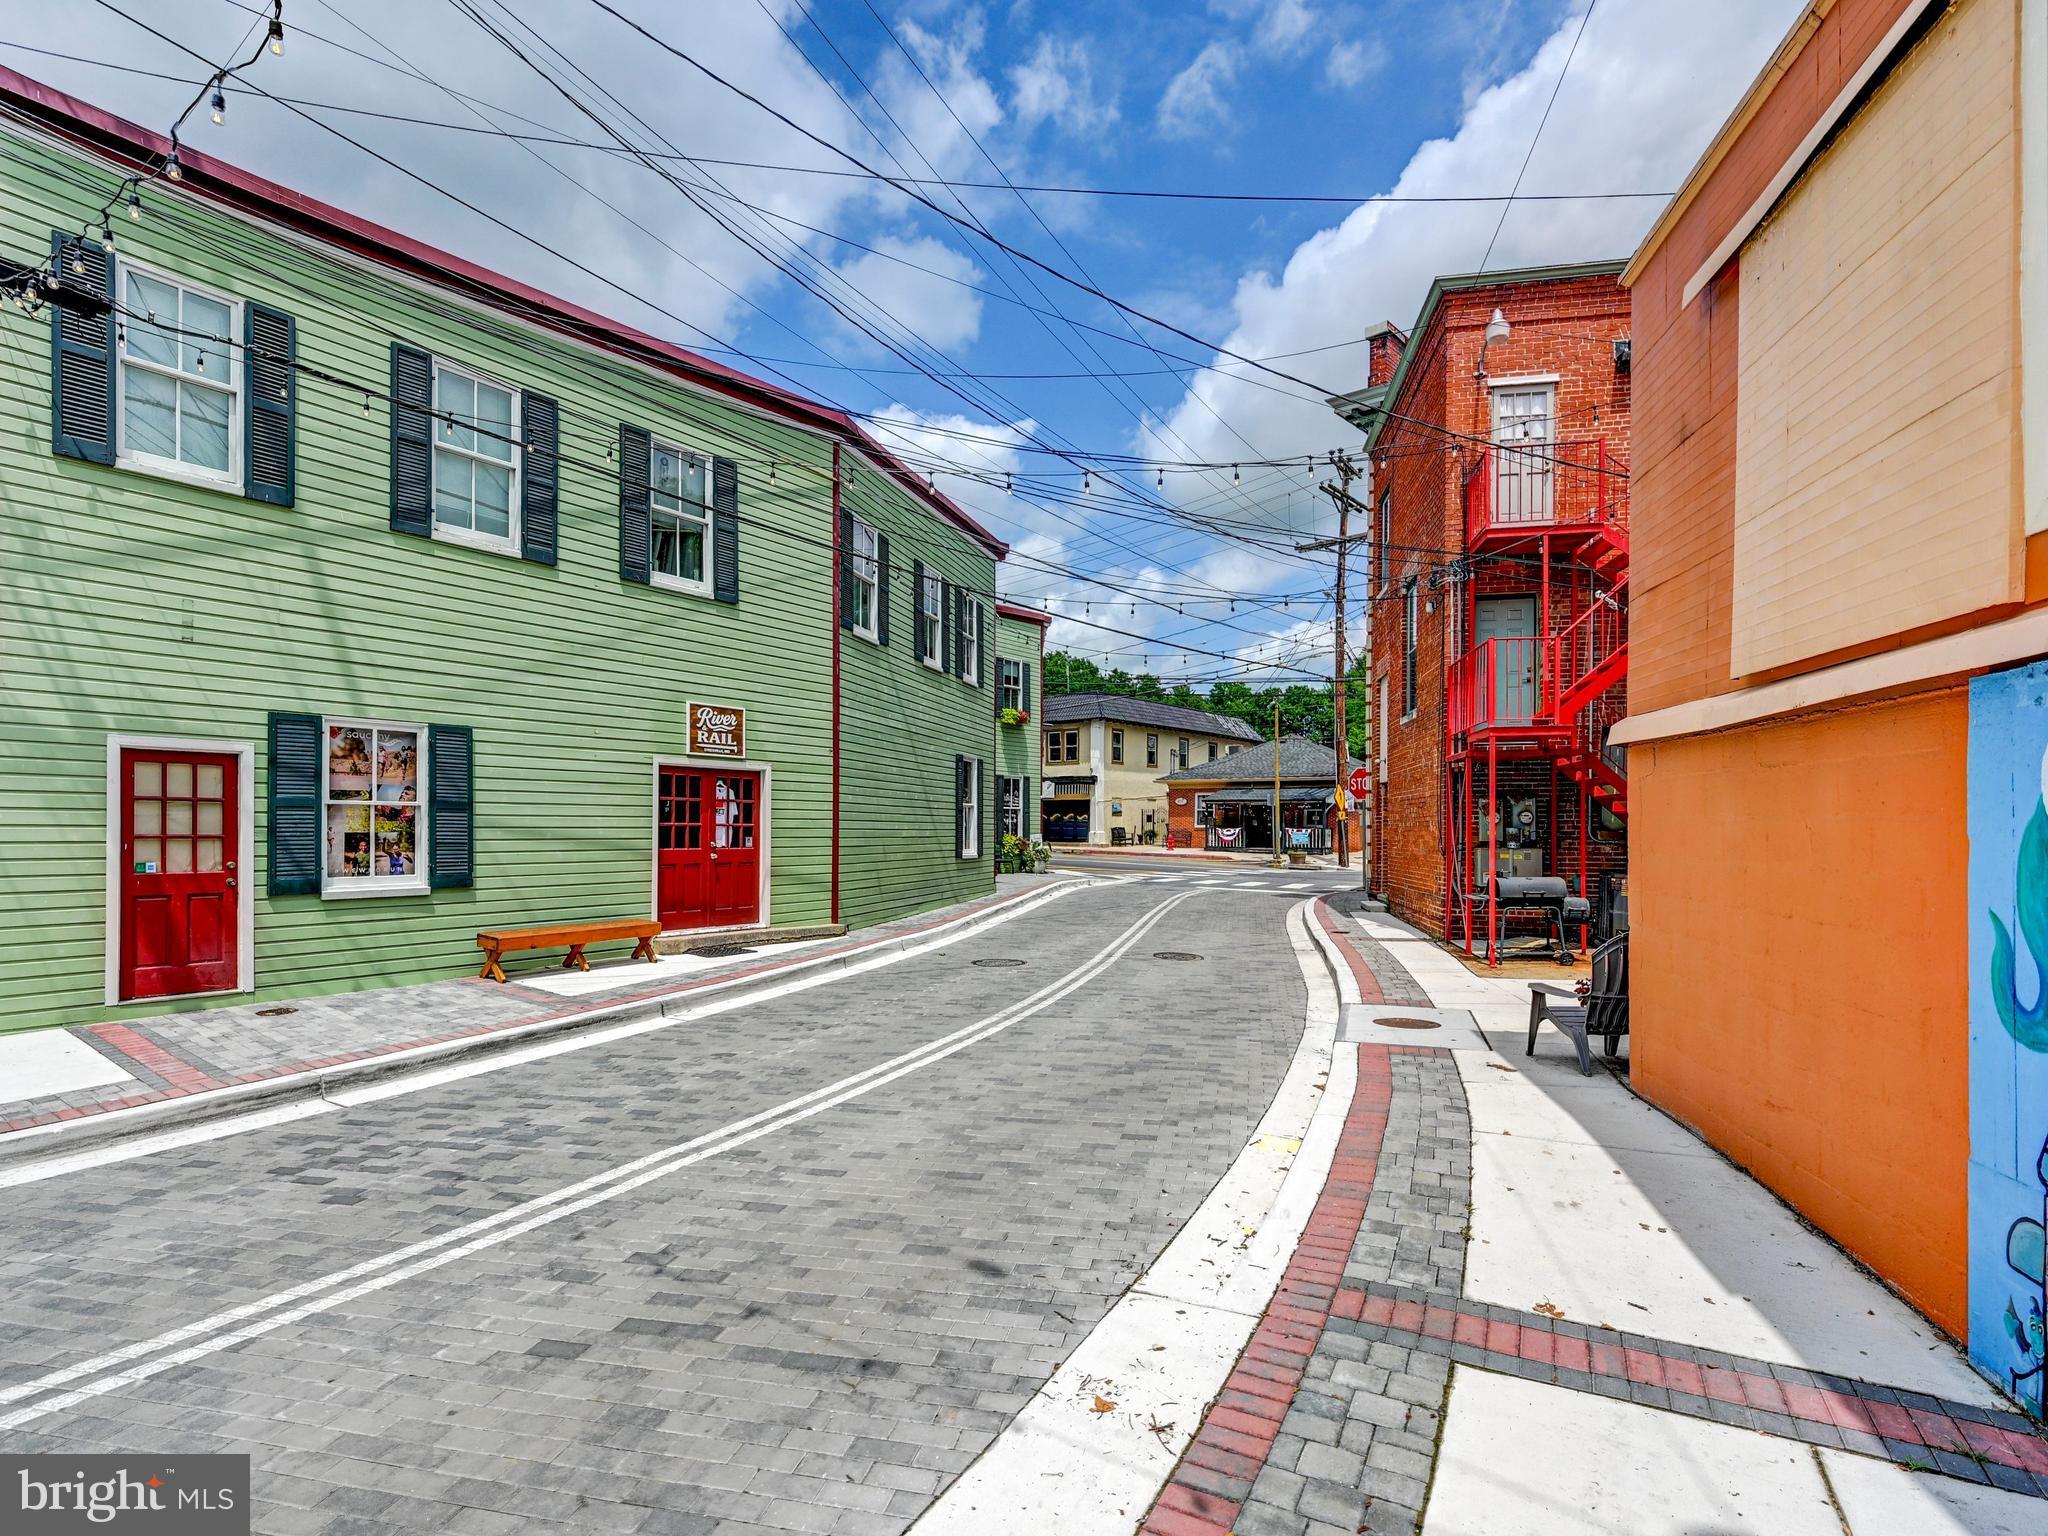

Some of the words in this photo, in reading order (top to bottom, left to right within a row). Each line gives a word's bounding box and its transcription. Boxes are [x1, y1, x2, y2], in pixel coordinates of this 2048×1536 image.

[696, 707, 738, 729] River
[346, 730, 391, 741] saucny
[697, 731, 737, 745] RAIL
[1350, 777, 1367, 790] STO
